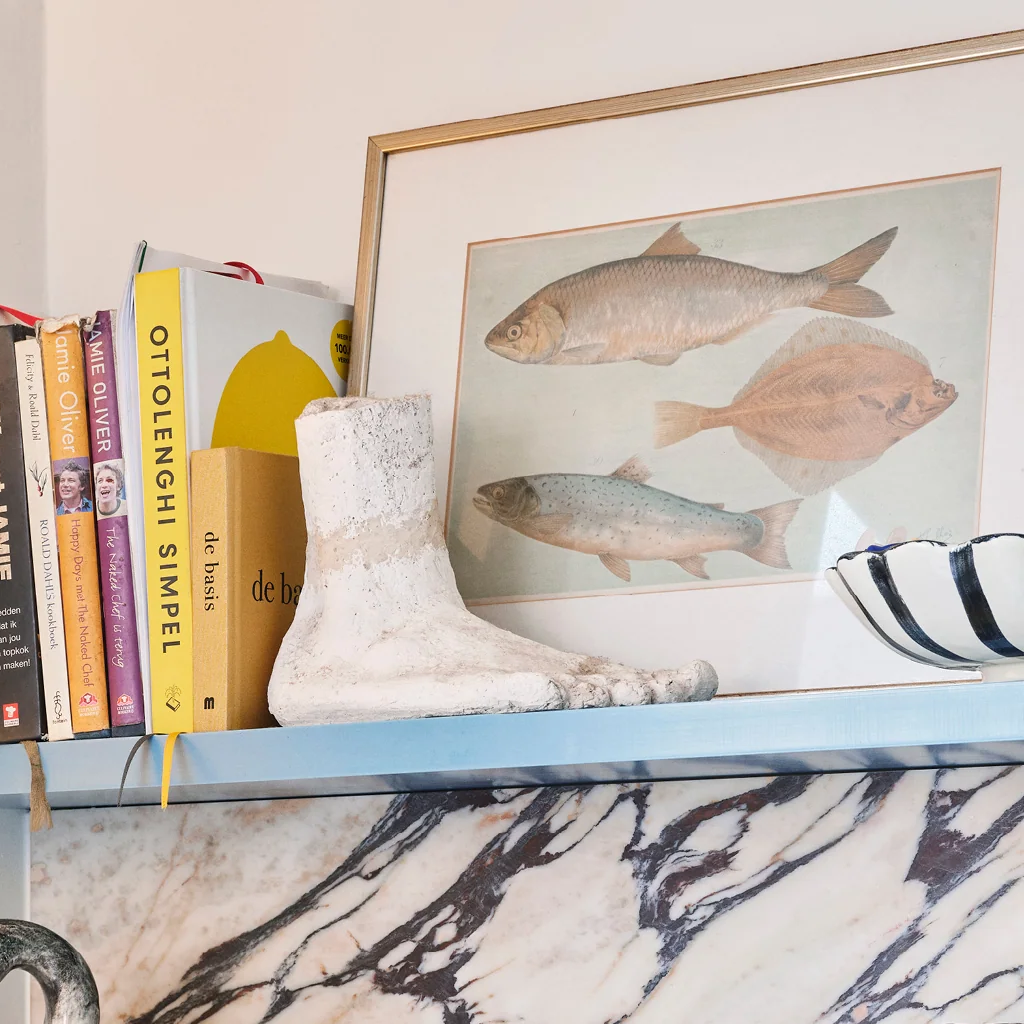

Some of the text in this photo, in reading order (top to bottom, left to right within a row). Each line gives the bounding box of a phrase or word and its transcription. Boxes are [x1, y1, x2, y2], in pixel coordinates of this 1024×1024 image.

[25, 354, 34, 382] Felicity
[29, 394, 39, 417] Roald
[60, 391, 80, 452] Oliver
[93, 382, 111, 454] OLIVER
[31, 421, 41, 440] Dahl
[150, 326, 180, 653] OTTOLENGHI SIMPEL
[106, 527, 119, 548] The
[40, 520, 50, 558] ROALD
[47, 603, 58, 650] kookboek
[109, 553, 122, 591] Naked
[204, 532, 219, 611] de basis
[252, 570, 274, 603] de
[70, 520, 94, 686] Happy Days met The Naked Chef
[3, 646, 29, 657] topkok
[9, 634, 20, 644] jou
[112, 637, 123, 668] terug
[4, 659, 30, 669] maken!
